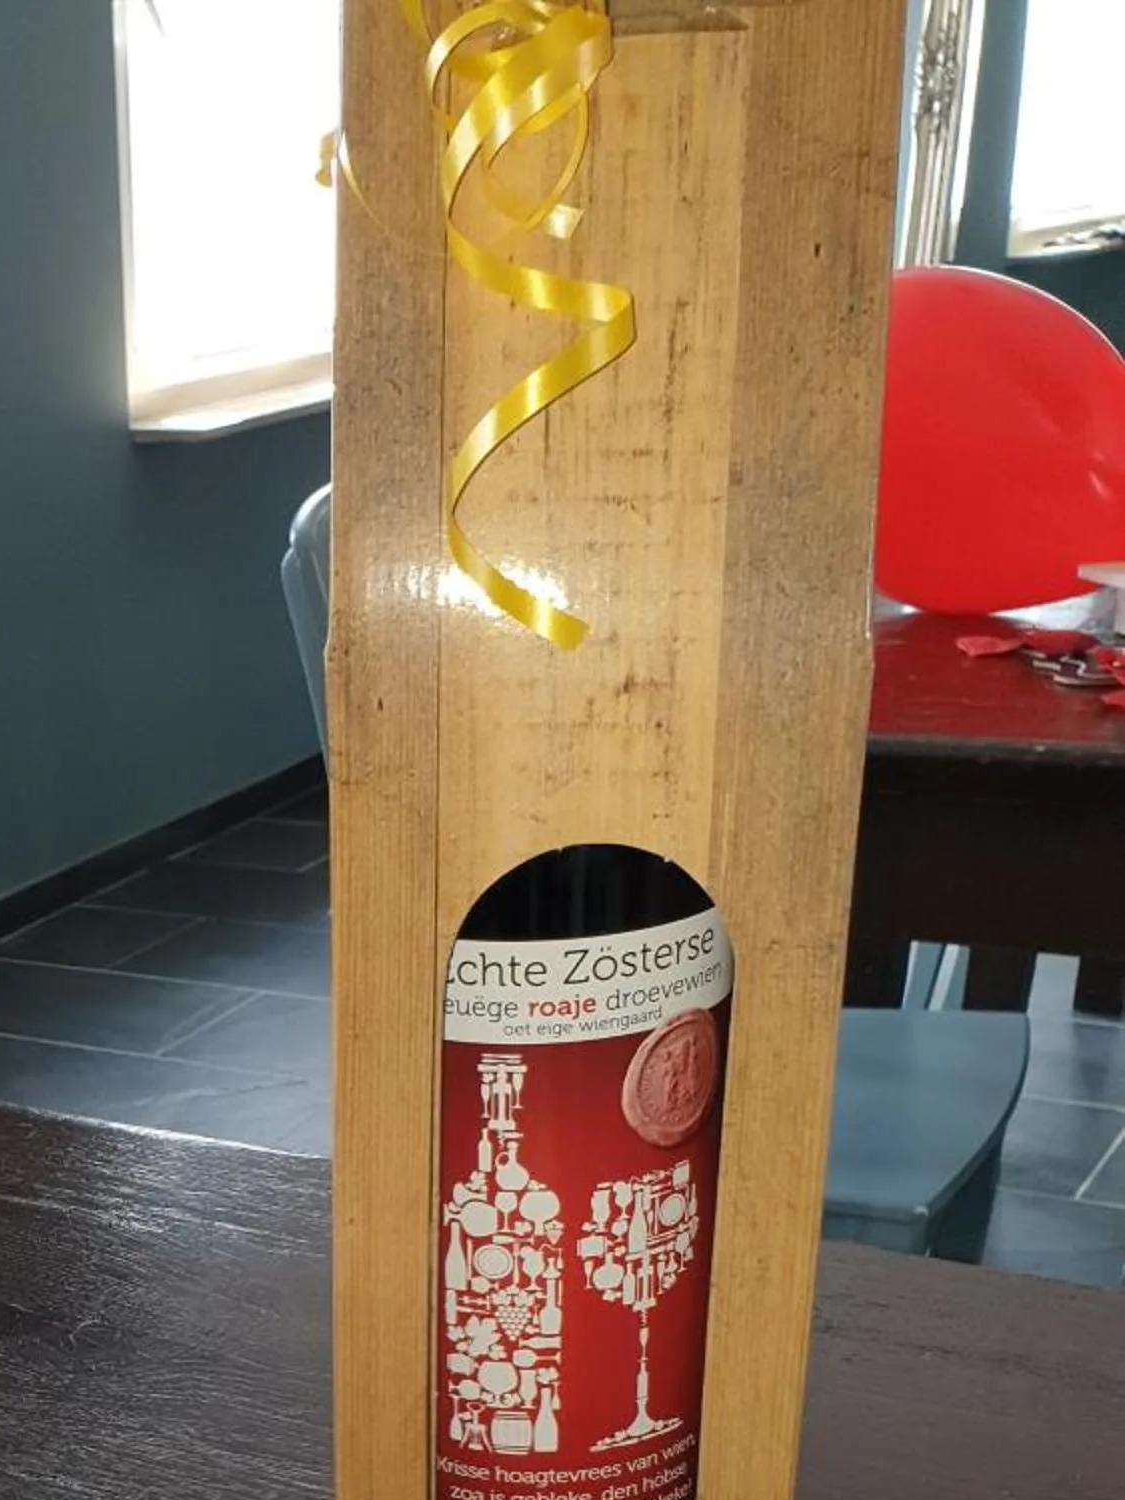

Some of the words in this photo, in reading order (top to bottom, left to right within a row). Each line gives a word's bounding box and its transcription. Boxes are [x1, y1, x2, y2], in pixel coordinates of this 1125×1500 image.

[563, 928, 713, 986] Zösterse
[528, 995, 596, 1022] roaje
[606, 962, 722, 1011] droevewien
[578, 1005, 662, 1031] wiengaard
[494, 1464, 622, 1488] hoagtevrees
[626, 1453, 658, 1472] van
